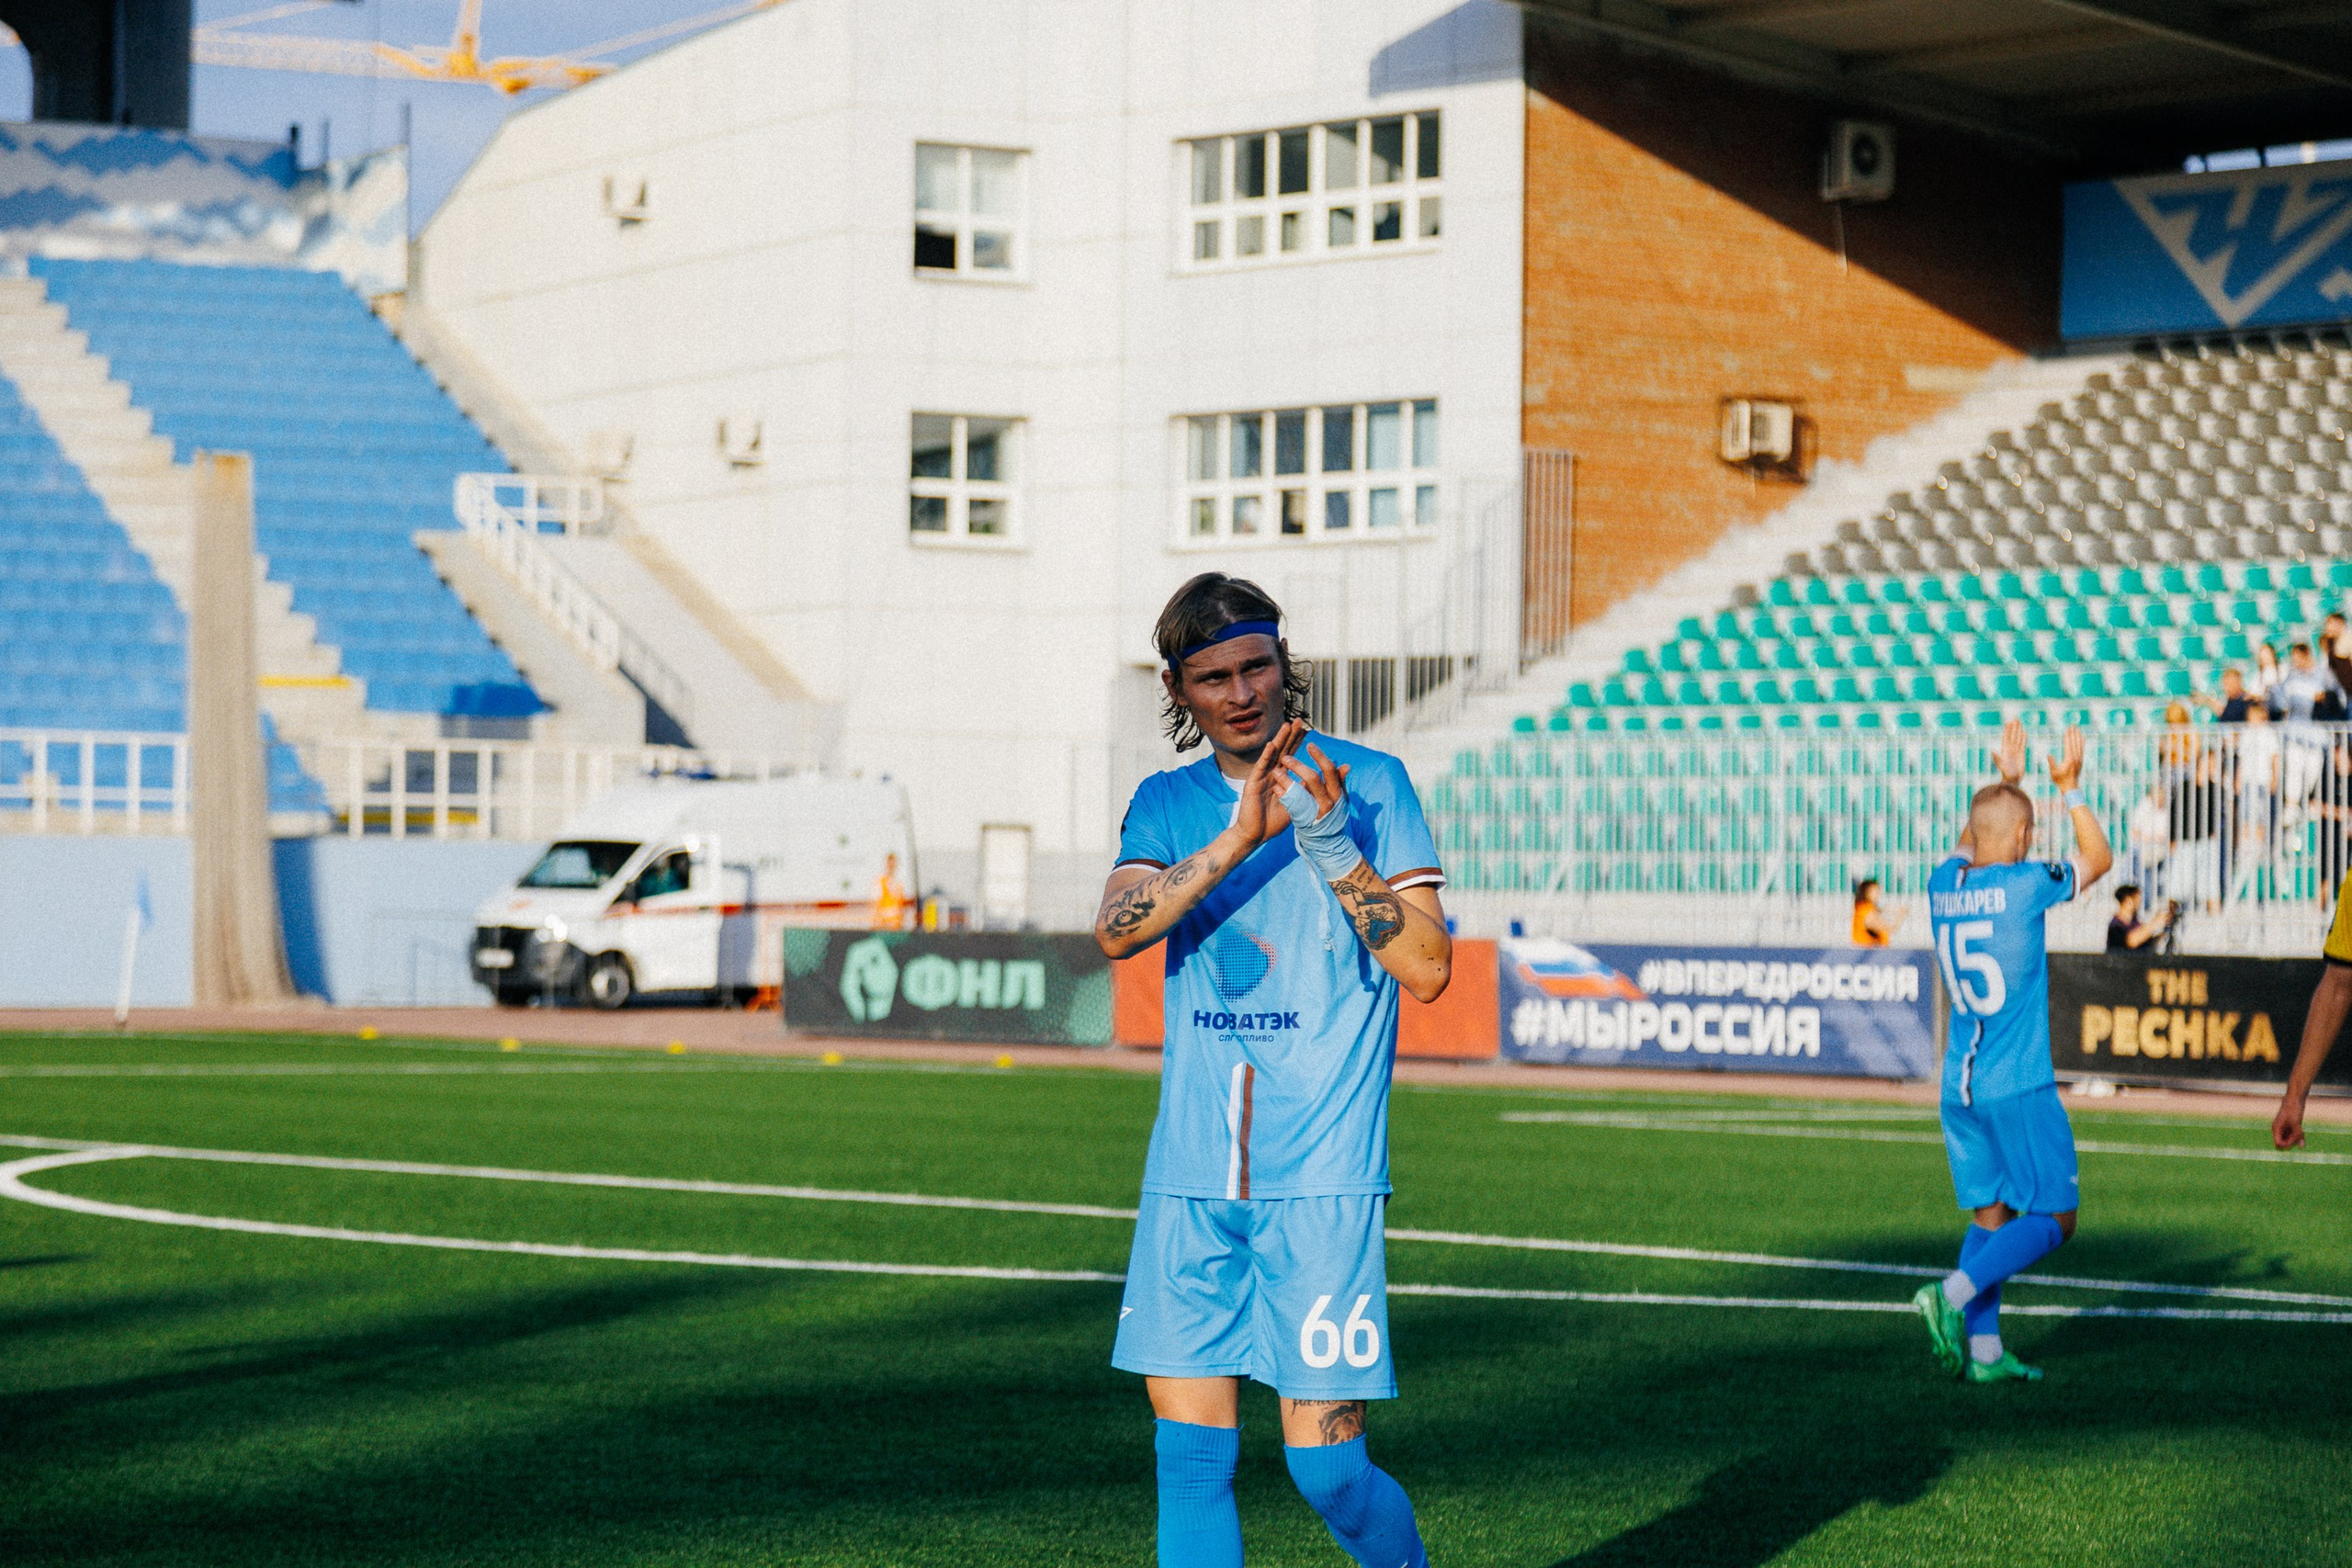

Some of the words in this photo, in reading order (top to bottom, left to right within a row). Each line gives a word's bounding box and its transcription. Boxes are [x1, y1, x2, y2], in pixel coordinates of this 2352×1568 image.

[901, 953, 1046, 1011] ФНЛ
[1638, 959, 1919, 1003] #ВПЕРЕДРОССИЯ
[1938, 920, 2007, 1017] 15
[2147, 968, 2209, 1005] THE
[1193, 1010, 1301, 1031] НОВАТЭК
[1510, 998, 1822, 1058] #МЫРОССИЯ
[2080, 1005, 2280, 1063] PECHKA
[1300, 1294, 1380, 1369] 66
